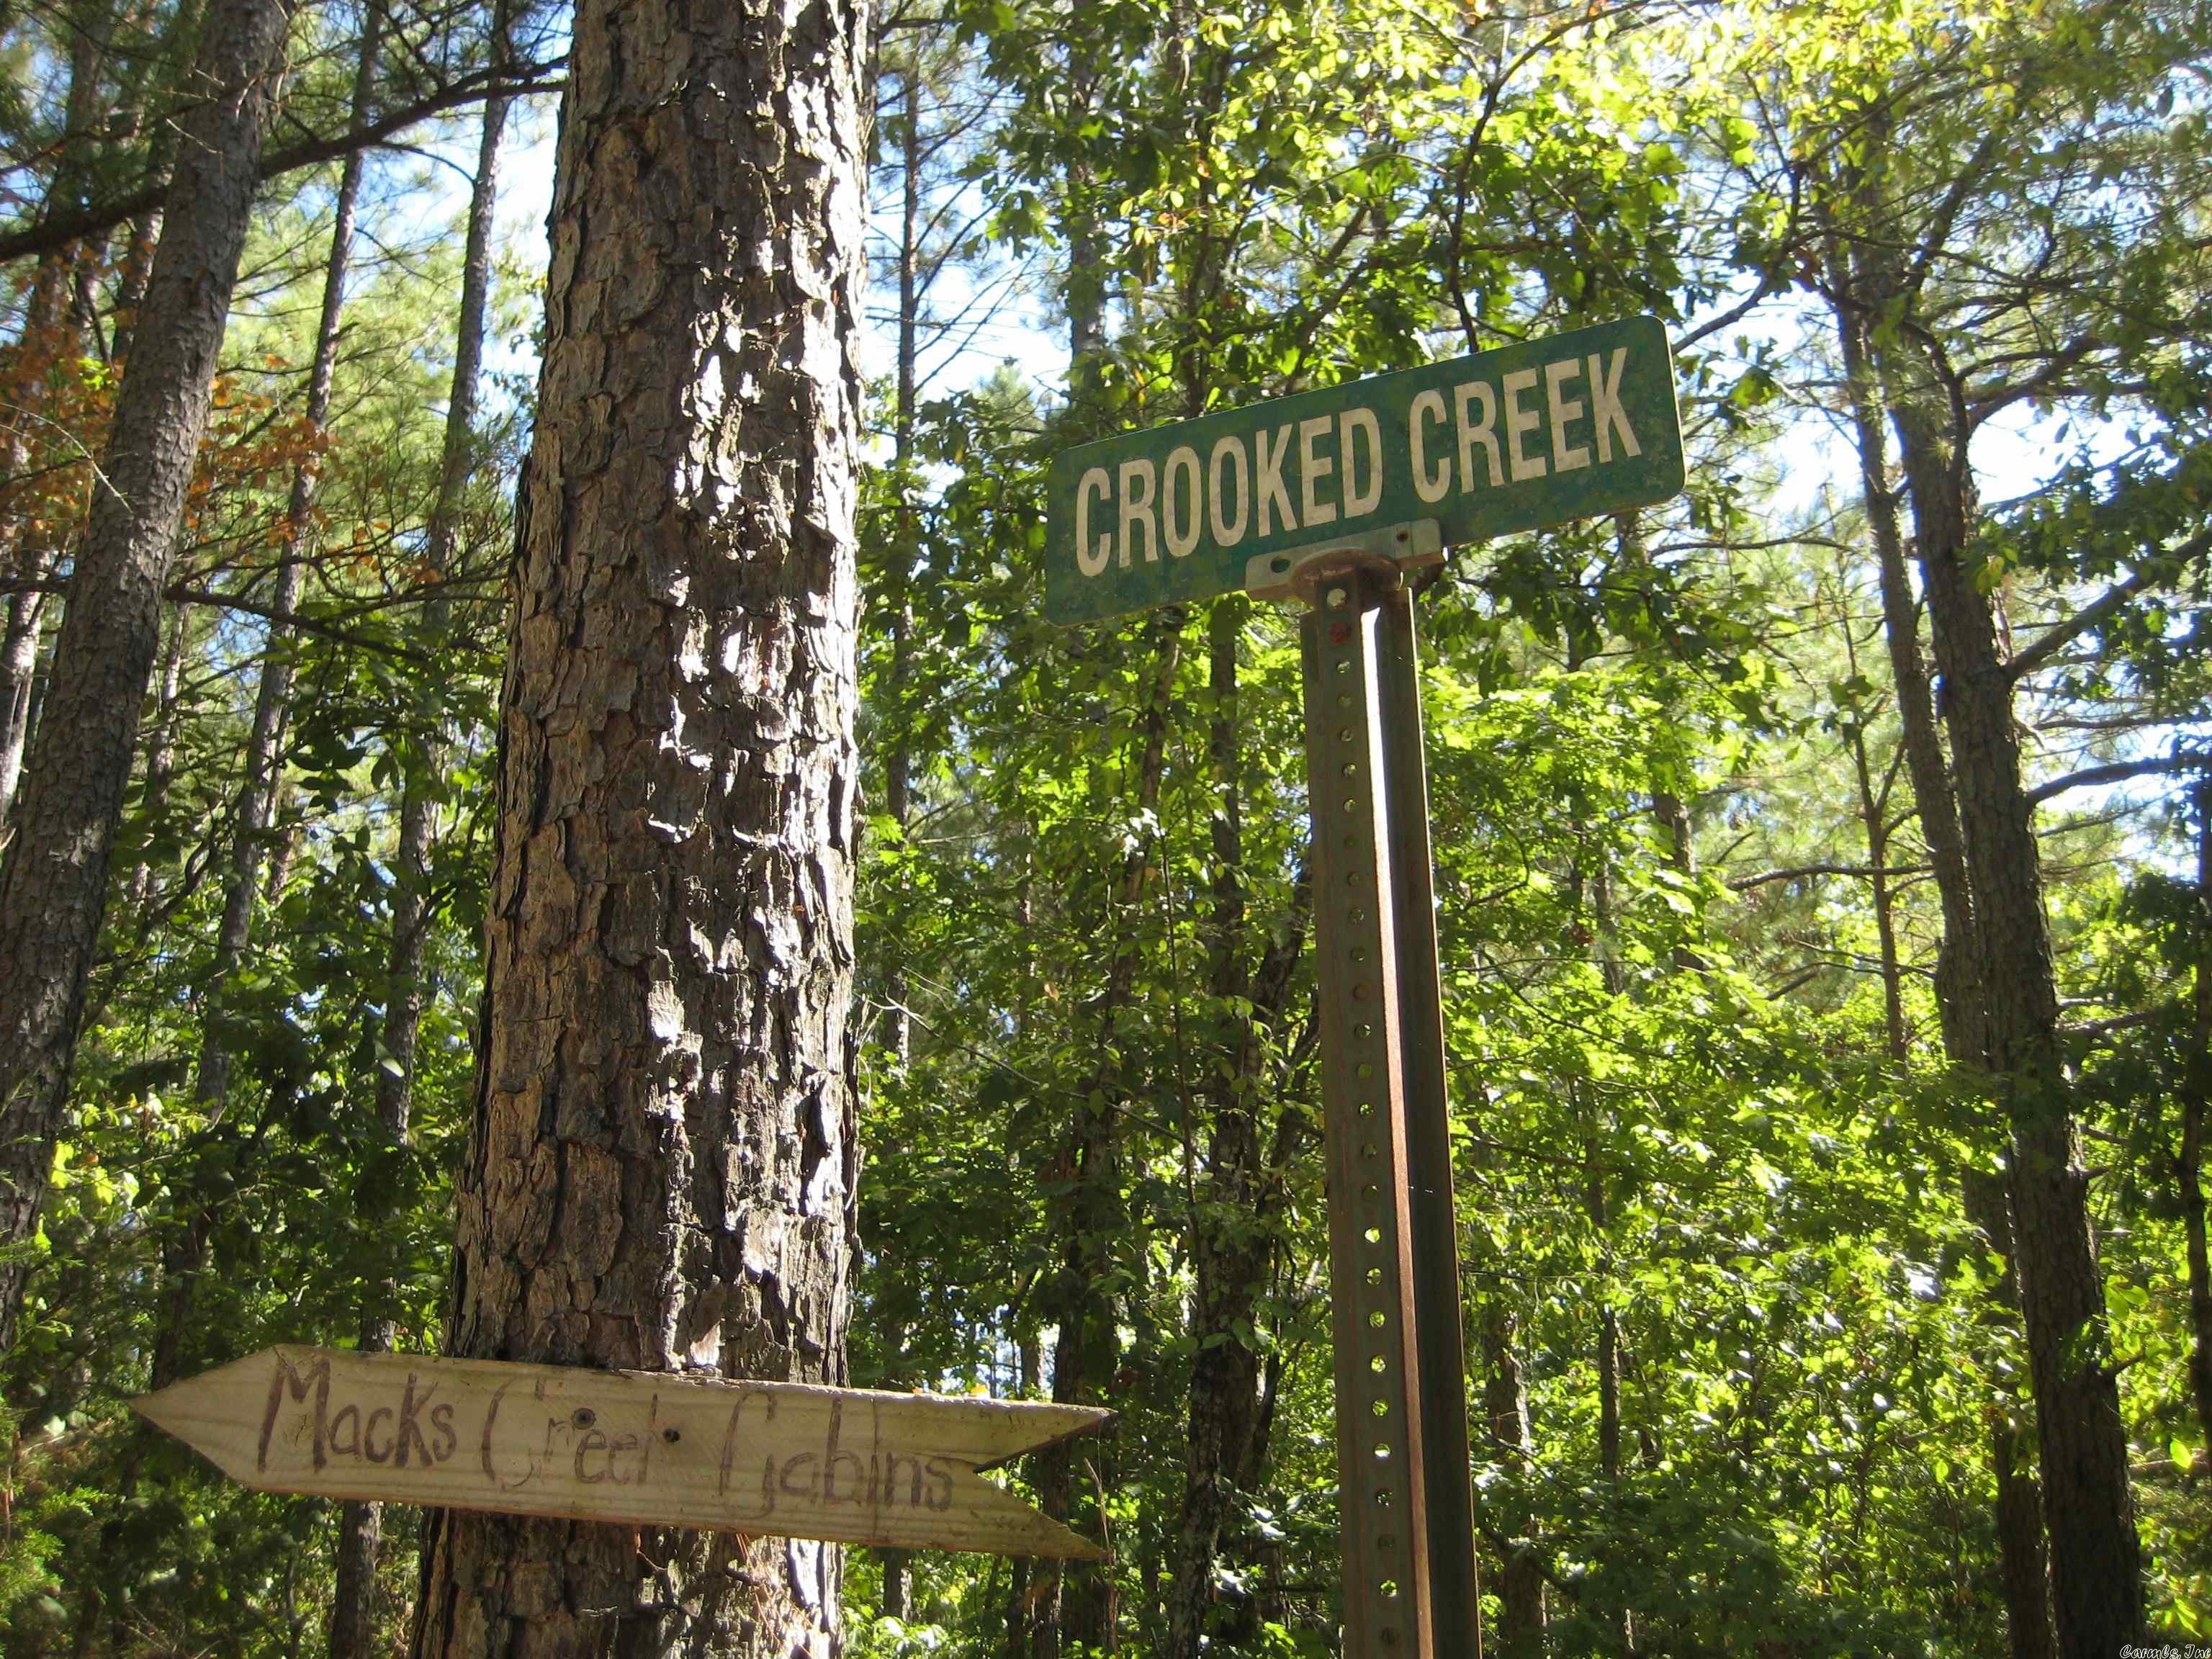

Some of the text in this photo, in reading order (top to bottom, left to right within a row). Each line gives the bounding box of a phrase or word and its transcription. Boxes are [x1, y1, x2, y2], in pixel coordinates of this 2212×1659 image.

[1076, 347, 1642, 577] CROOKED CREEK
[257, 1357, 457, 1475] Macks
[719, 1388, 953, 1519] Cabins
